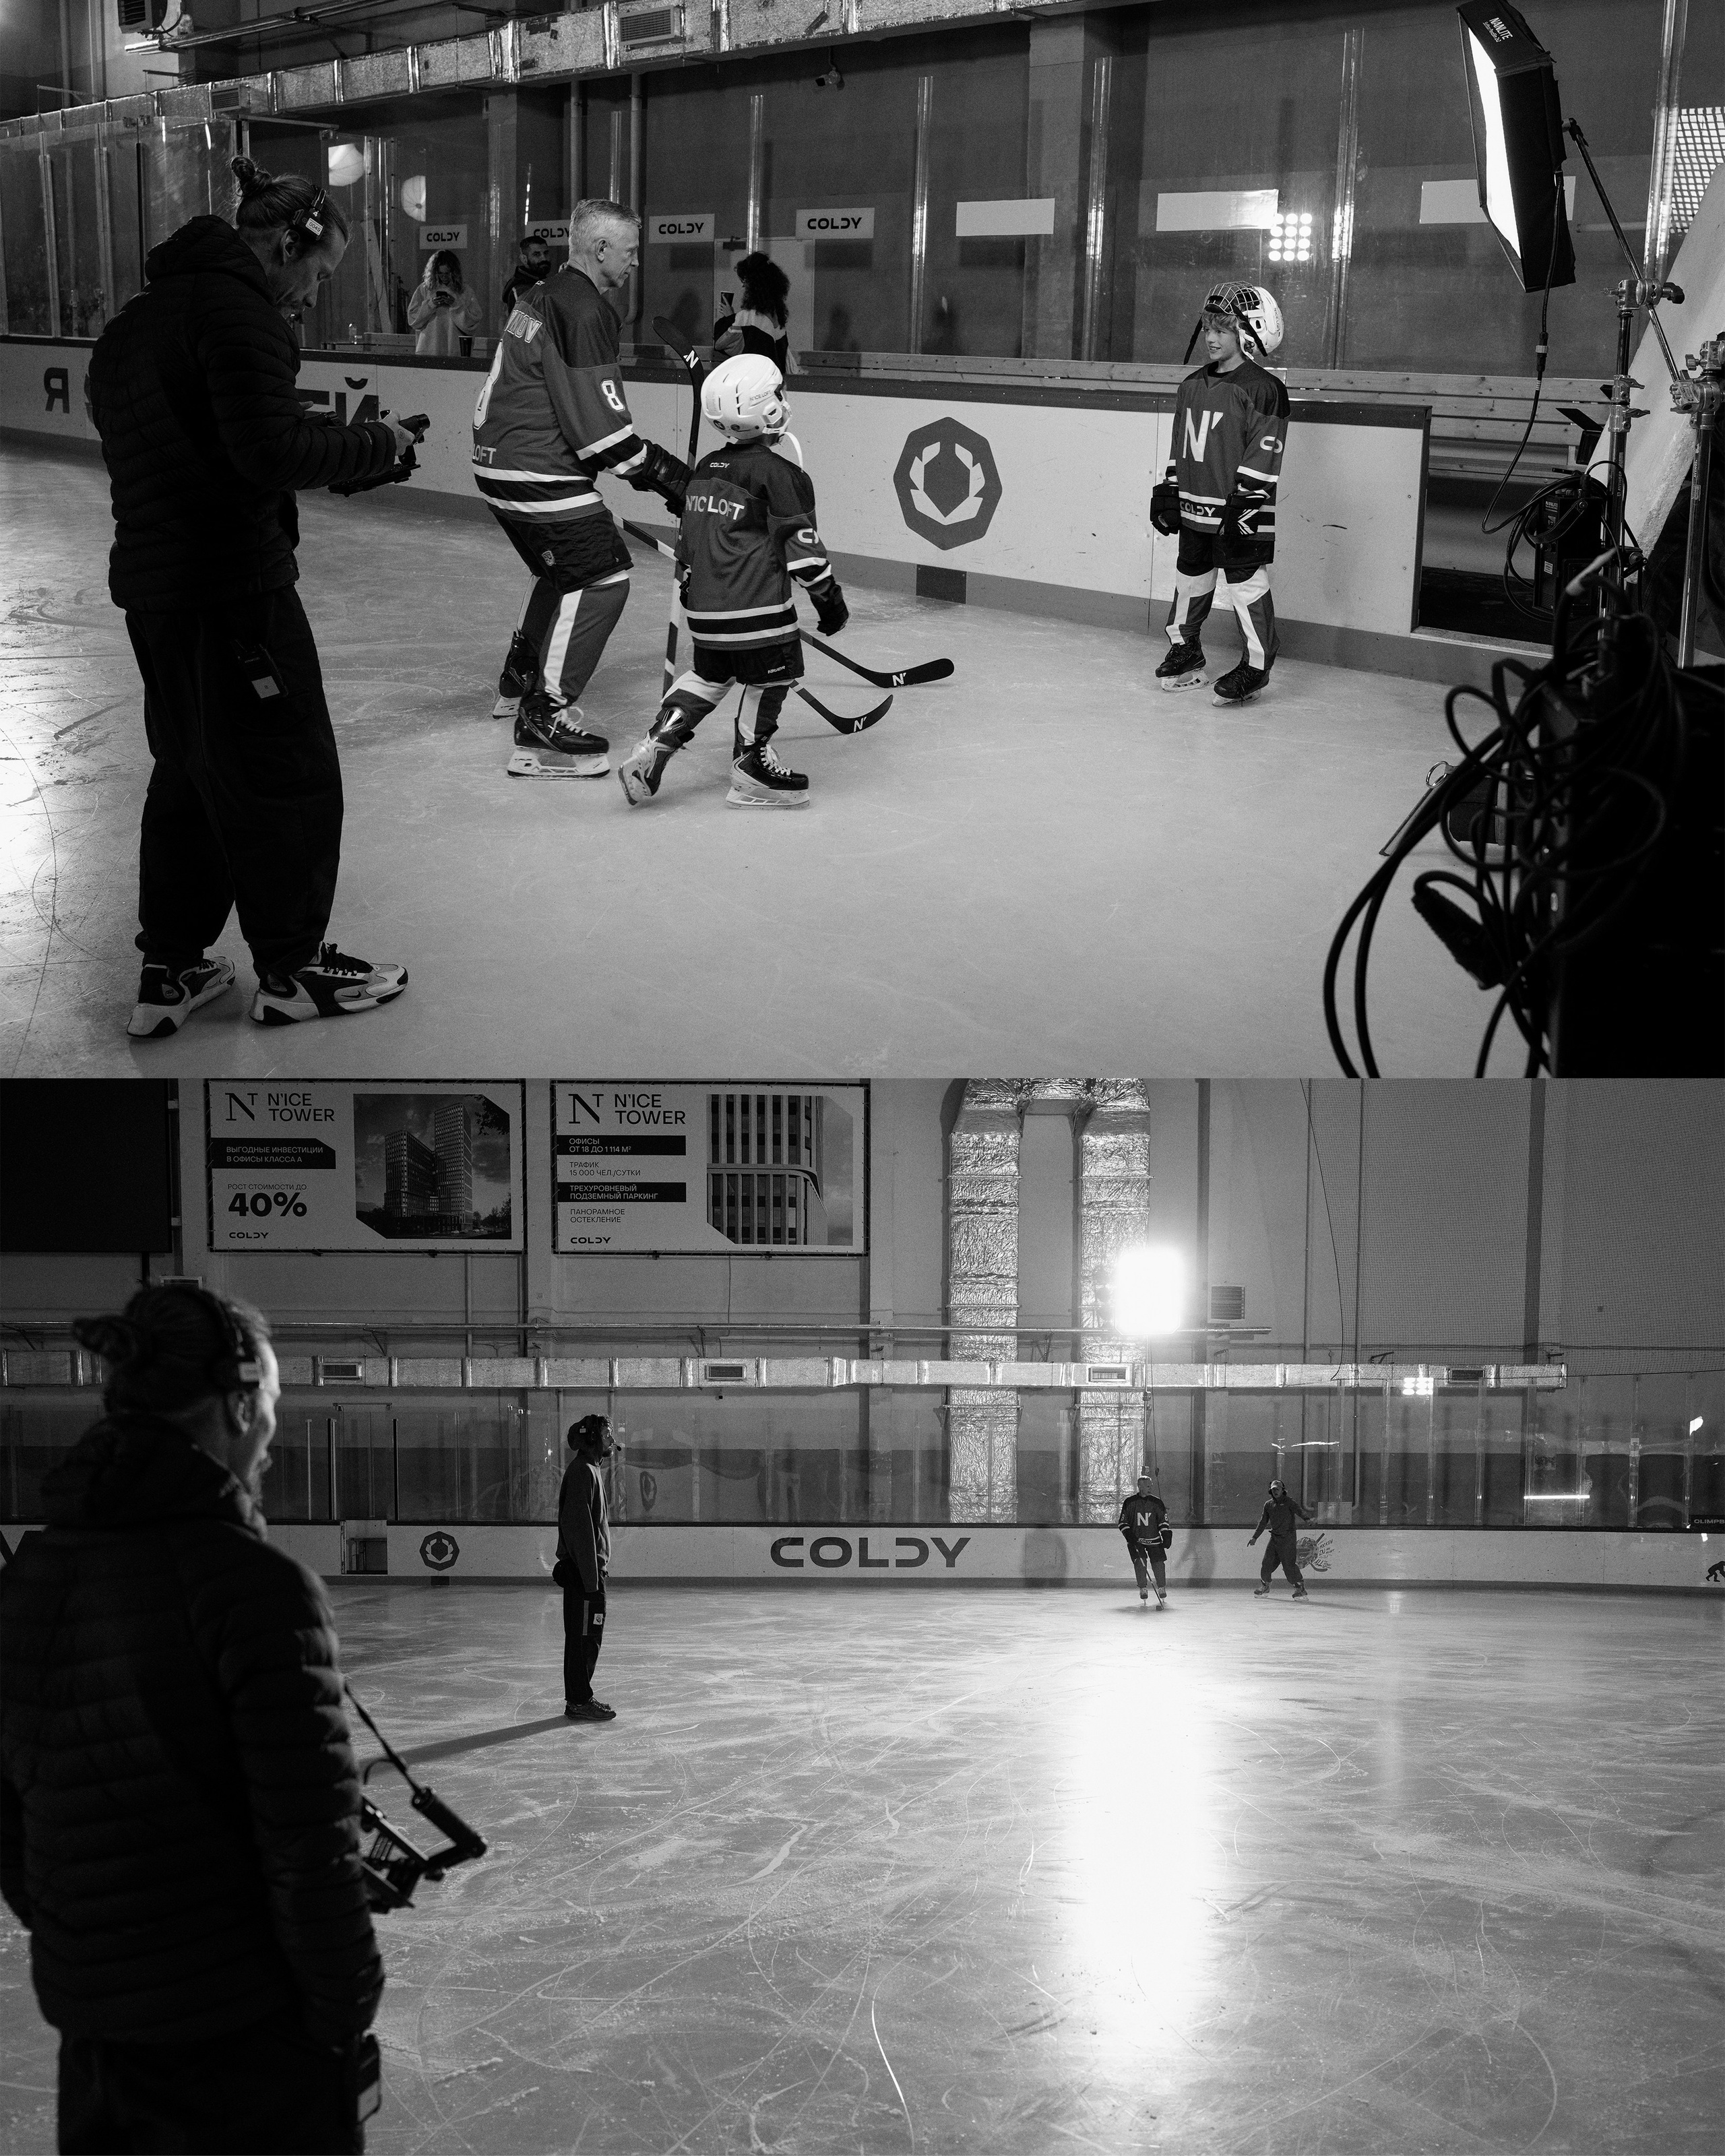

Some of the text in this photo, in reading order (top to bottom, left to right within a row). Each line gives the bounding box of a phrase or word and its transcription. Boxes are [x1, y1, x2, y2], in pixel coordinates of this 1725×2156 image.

[1488, 17, 1513, 40] NANLITE
[658, 222, 705, 234] COLDY
[807, 217, 862, 230] COLDY
[426, 232, 460, 242] COLDY
[600, 378, 625, 412] 8
[708, 495, 745, 520] LOFT
[1179, 501, 1216, 517] COLDY
[268, 1108, 335, 1122] TOWER
[615, 1110, 686, 1124] TOWER
[233, 1155, 263, 1163] ОФИСЫ
[569, 1184, 637, 1192] ТРЕХУРОВНЕВЫЙ
[570, 1192, 621, 1200] ПОДЗЕМНЫЙ
[228, 1191, 307, 1217] 40%
[770, 1537, 972, 1568] COLDY
